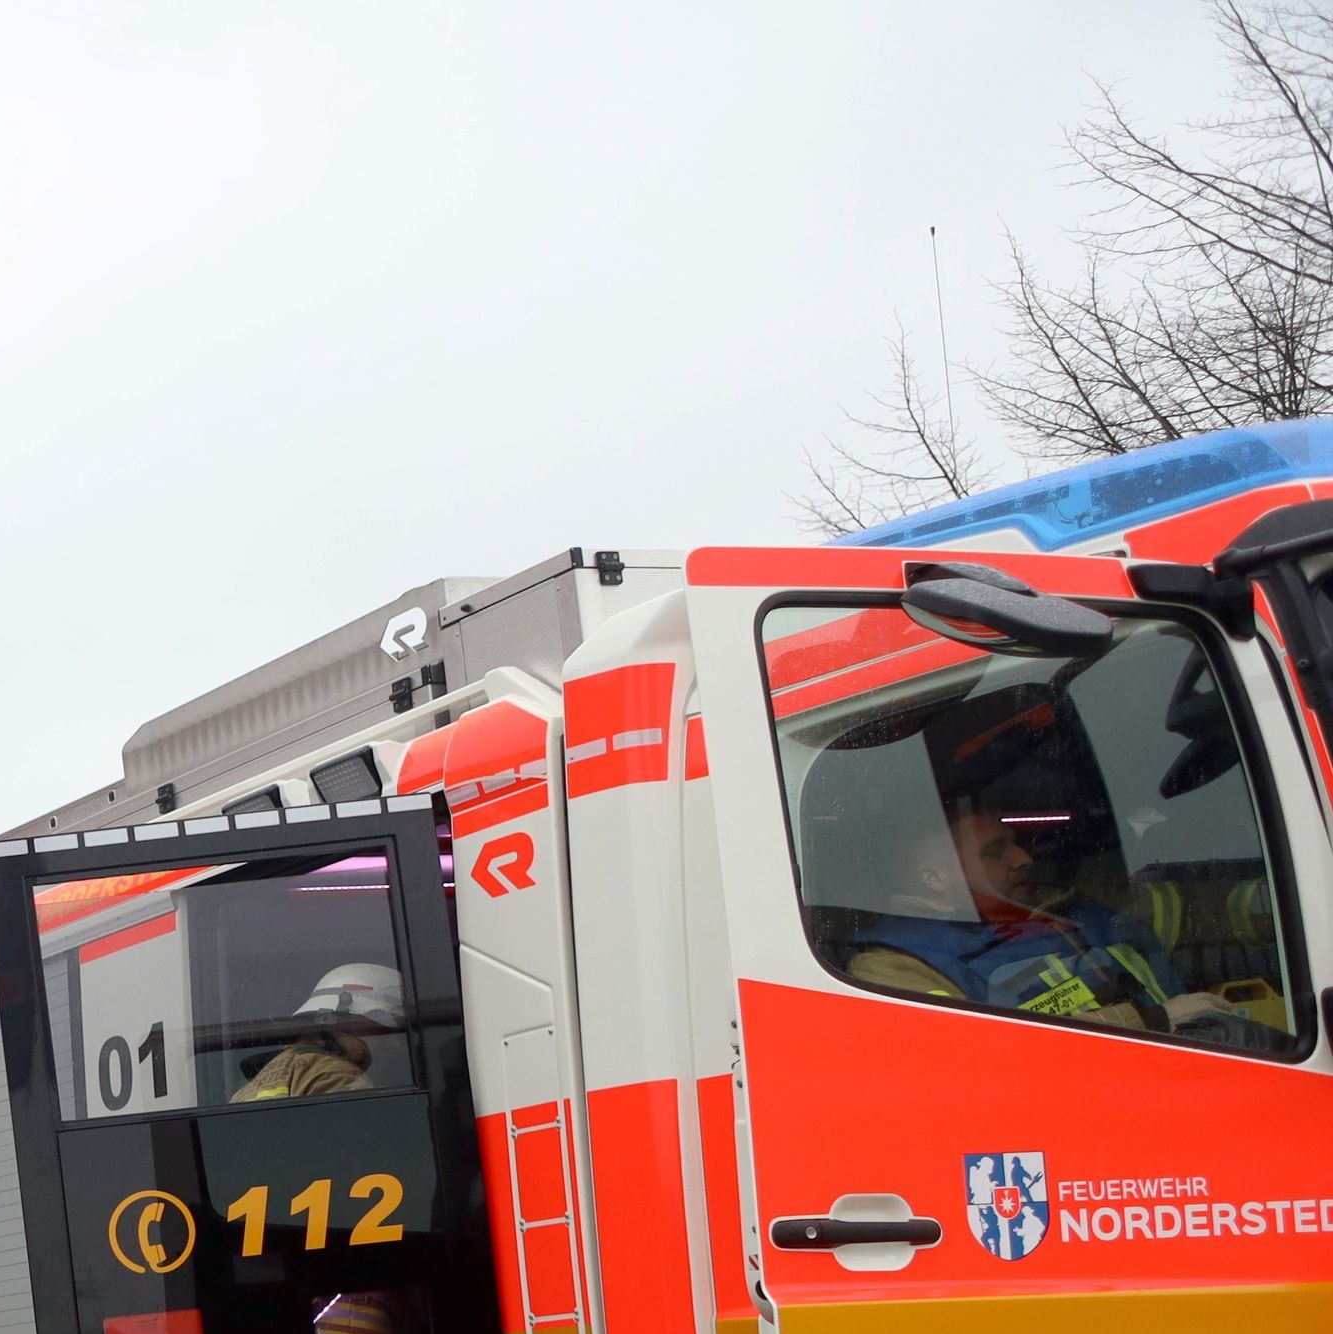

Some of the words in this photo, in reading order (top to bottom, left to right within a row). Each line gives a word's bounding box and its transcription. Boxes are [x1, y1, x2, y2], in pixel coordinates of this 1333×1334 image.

[98, 1021, 169, 1112] 01
[227, 1174, 404, 1258] 112
[1057, 1176, 1209, 1202] FEUERWEHR
